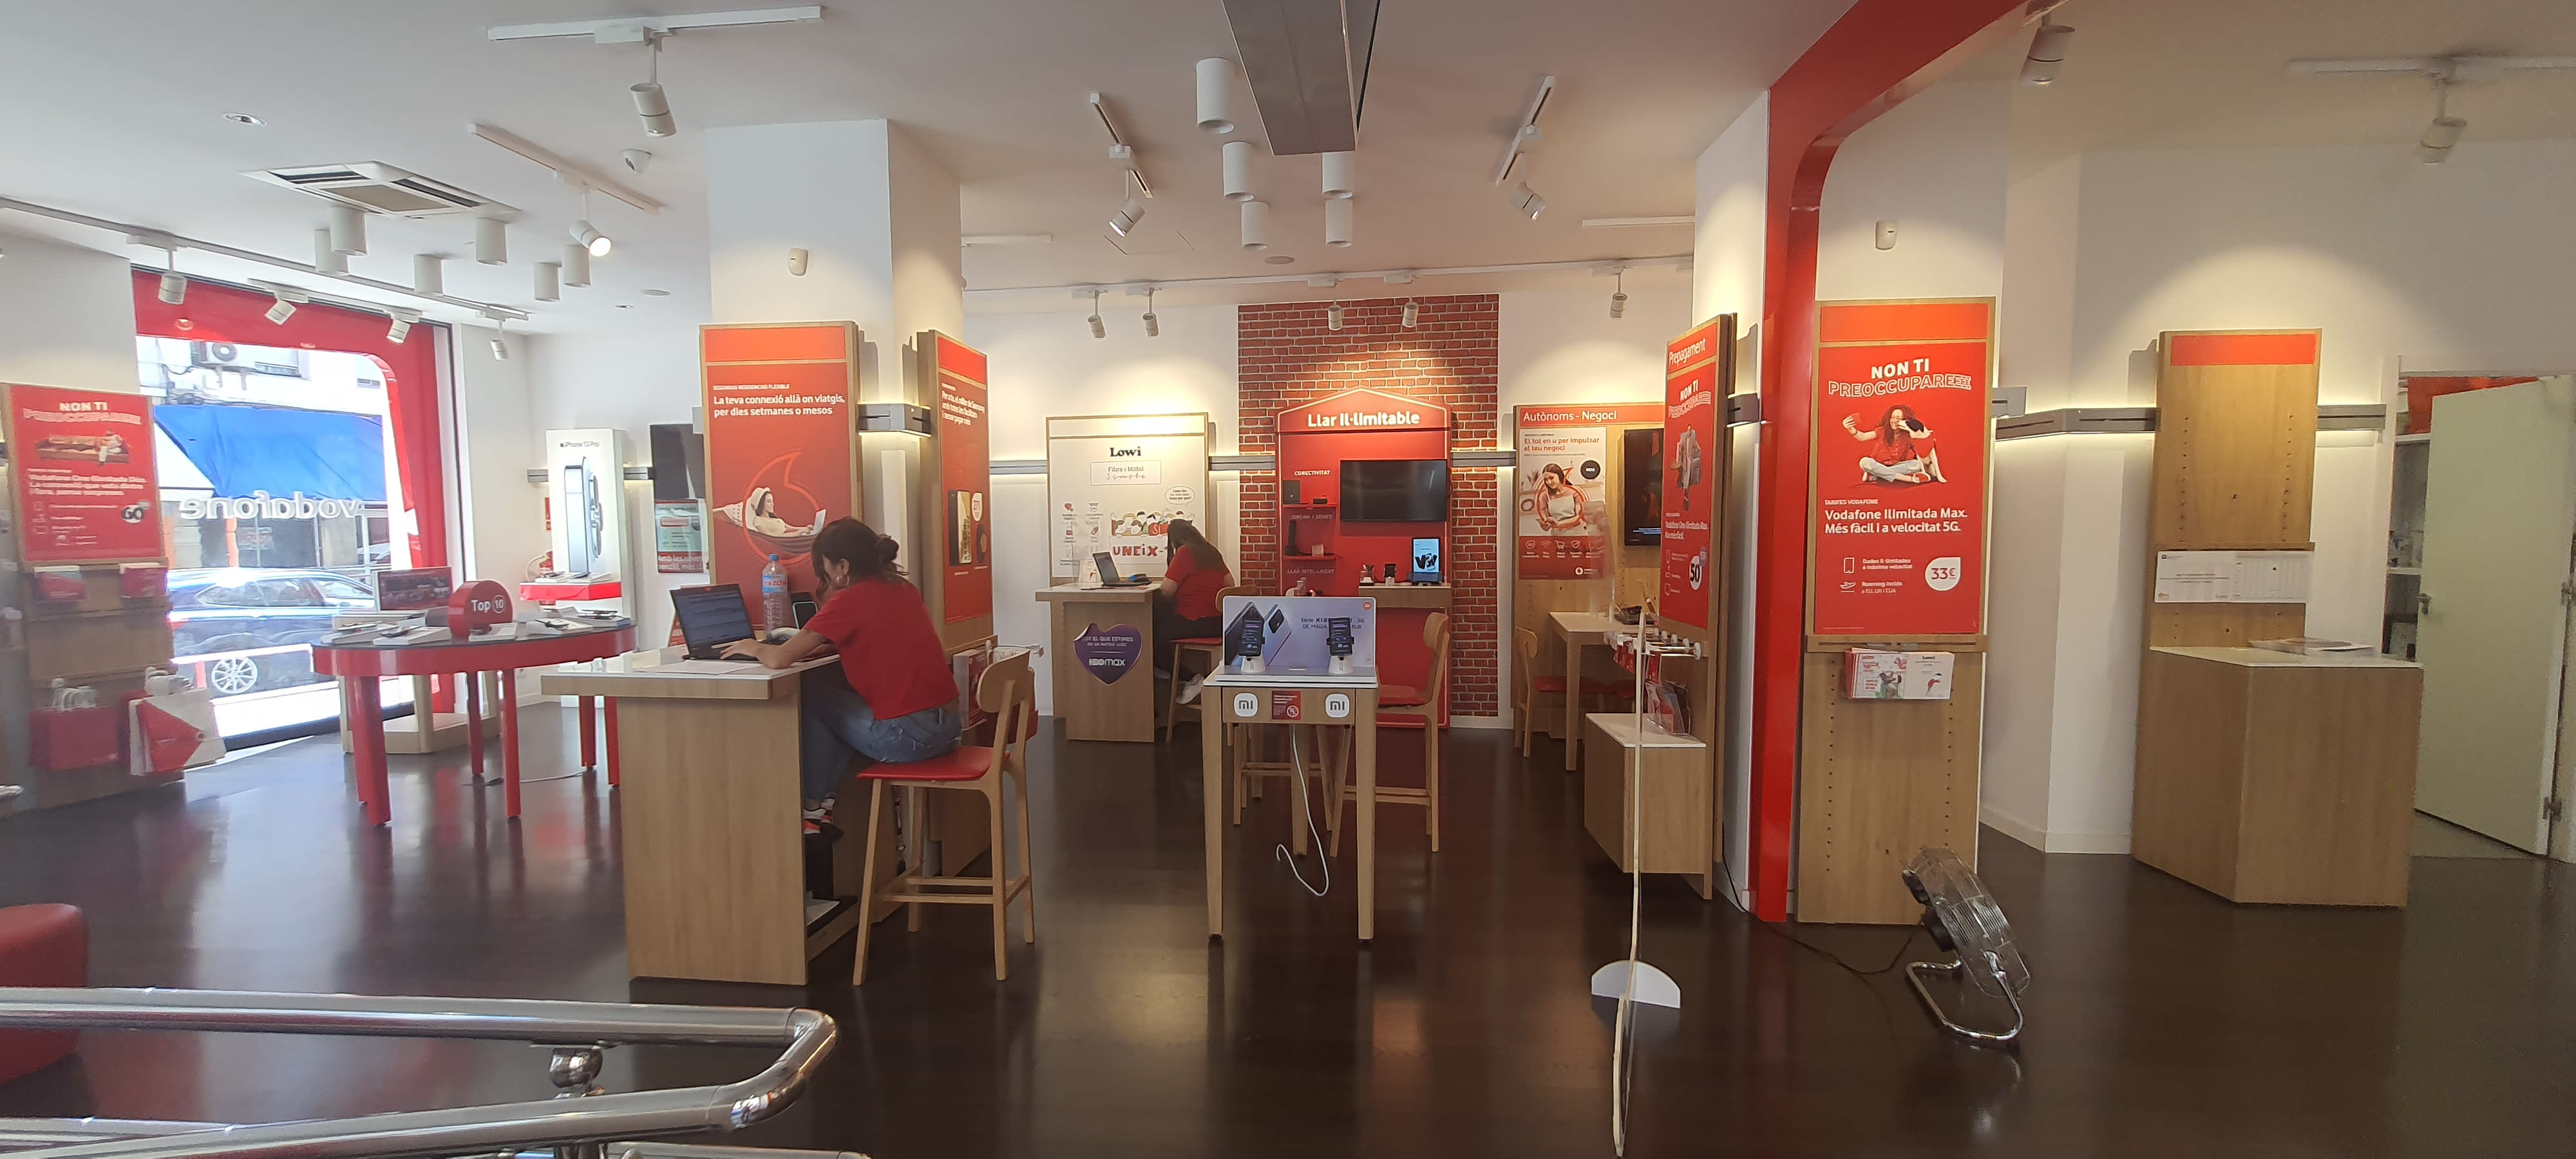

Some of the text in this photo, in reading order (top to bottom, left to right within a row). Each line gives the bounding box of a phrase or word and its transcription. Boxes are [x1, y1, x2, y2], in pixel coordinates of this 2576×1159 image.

[1669, 337, 1706, 366] Prepagament
[1871, 359, 1929, 379] NON TI
[1680, 379, 1698, 401] NON TI
[714, 396, 724, 404] La
[745, 395, 783, 404] connexió
[785, 395, 800, 403] allà
[814, 394, 845, 404] viatgis,
[59, 402, 108, 411] NON TI
[714, 409, 728, 418] per
[730, 408, 748, 416] dies
[1523, 411, 1574, 422] Autònoms
[1582, 410, 1616, 422] Negoci
[1307, 413, 1337, 428] Llar
[1110, 446, 1141, 457] Lowi
[1825, 508, 1968, 520] Vodafone Ilimitada Max.
[1825, 523, 1848, 534] Més
[1850, 522, 1873, 533] fàcil
[1882, 524, 1889, 532] a
[1891, 522, 1940, 532] velocitat
[1942, 522, 1961, 531] 5G.
[1690, 563, 1700, 582] 50
[1931, 567, 1956, 580] 33€
[471, 599, 504, 613] Top 10
